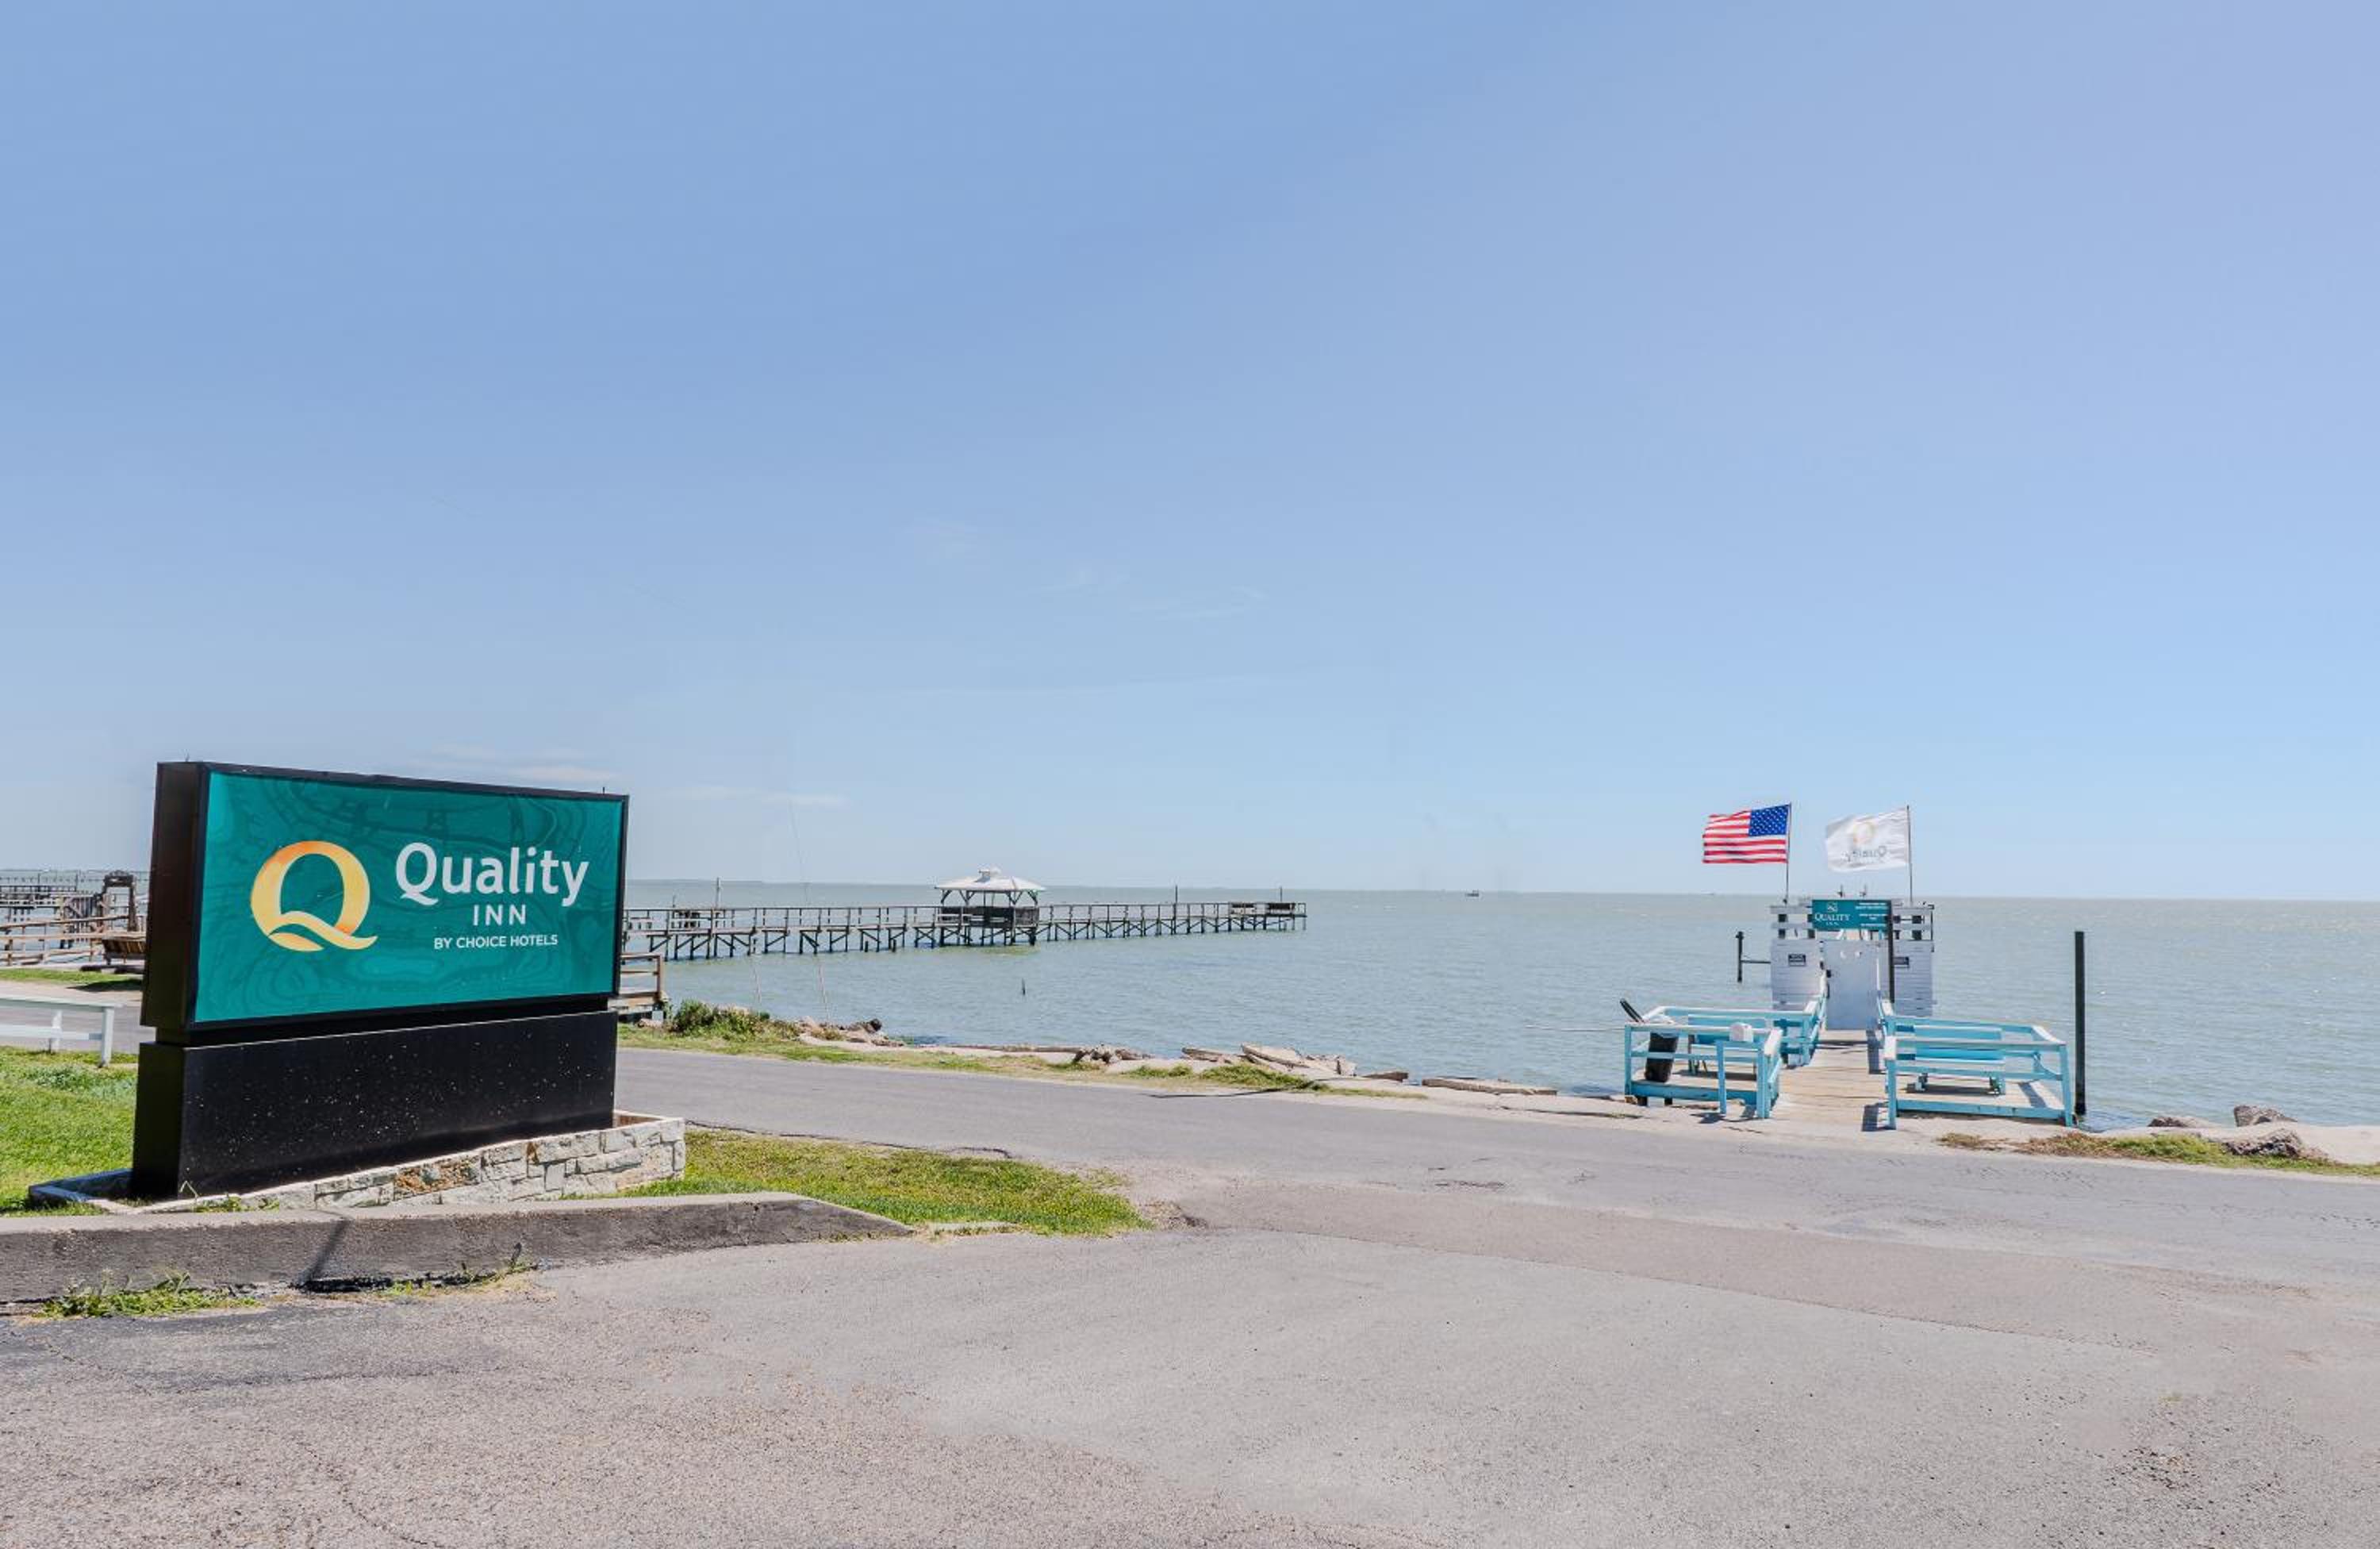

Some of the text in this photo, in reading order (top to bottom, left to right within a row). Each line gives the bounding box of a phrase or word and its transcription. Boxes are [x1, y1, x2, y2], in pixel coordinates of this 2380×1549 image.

[396, 842, 589, 907] Quality
[250, 840, 378, 952] Q
[473, 905, 527, 926] INN
[1814, 912, 1850, 921] QUALITY
[434, 934, 559, 949] BY CHOICE HOTELS
